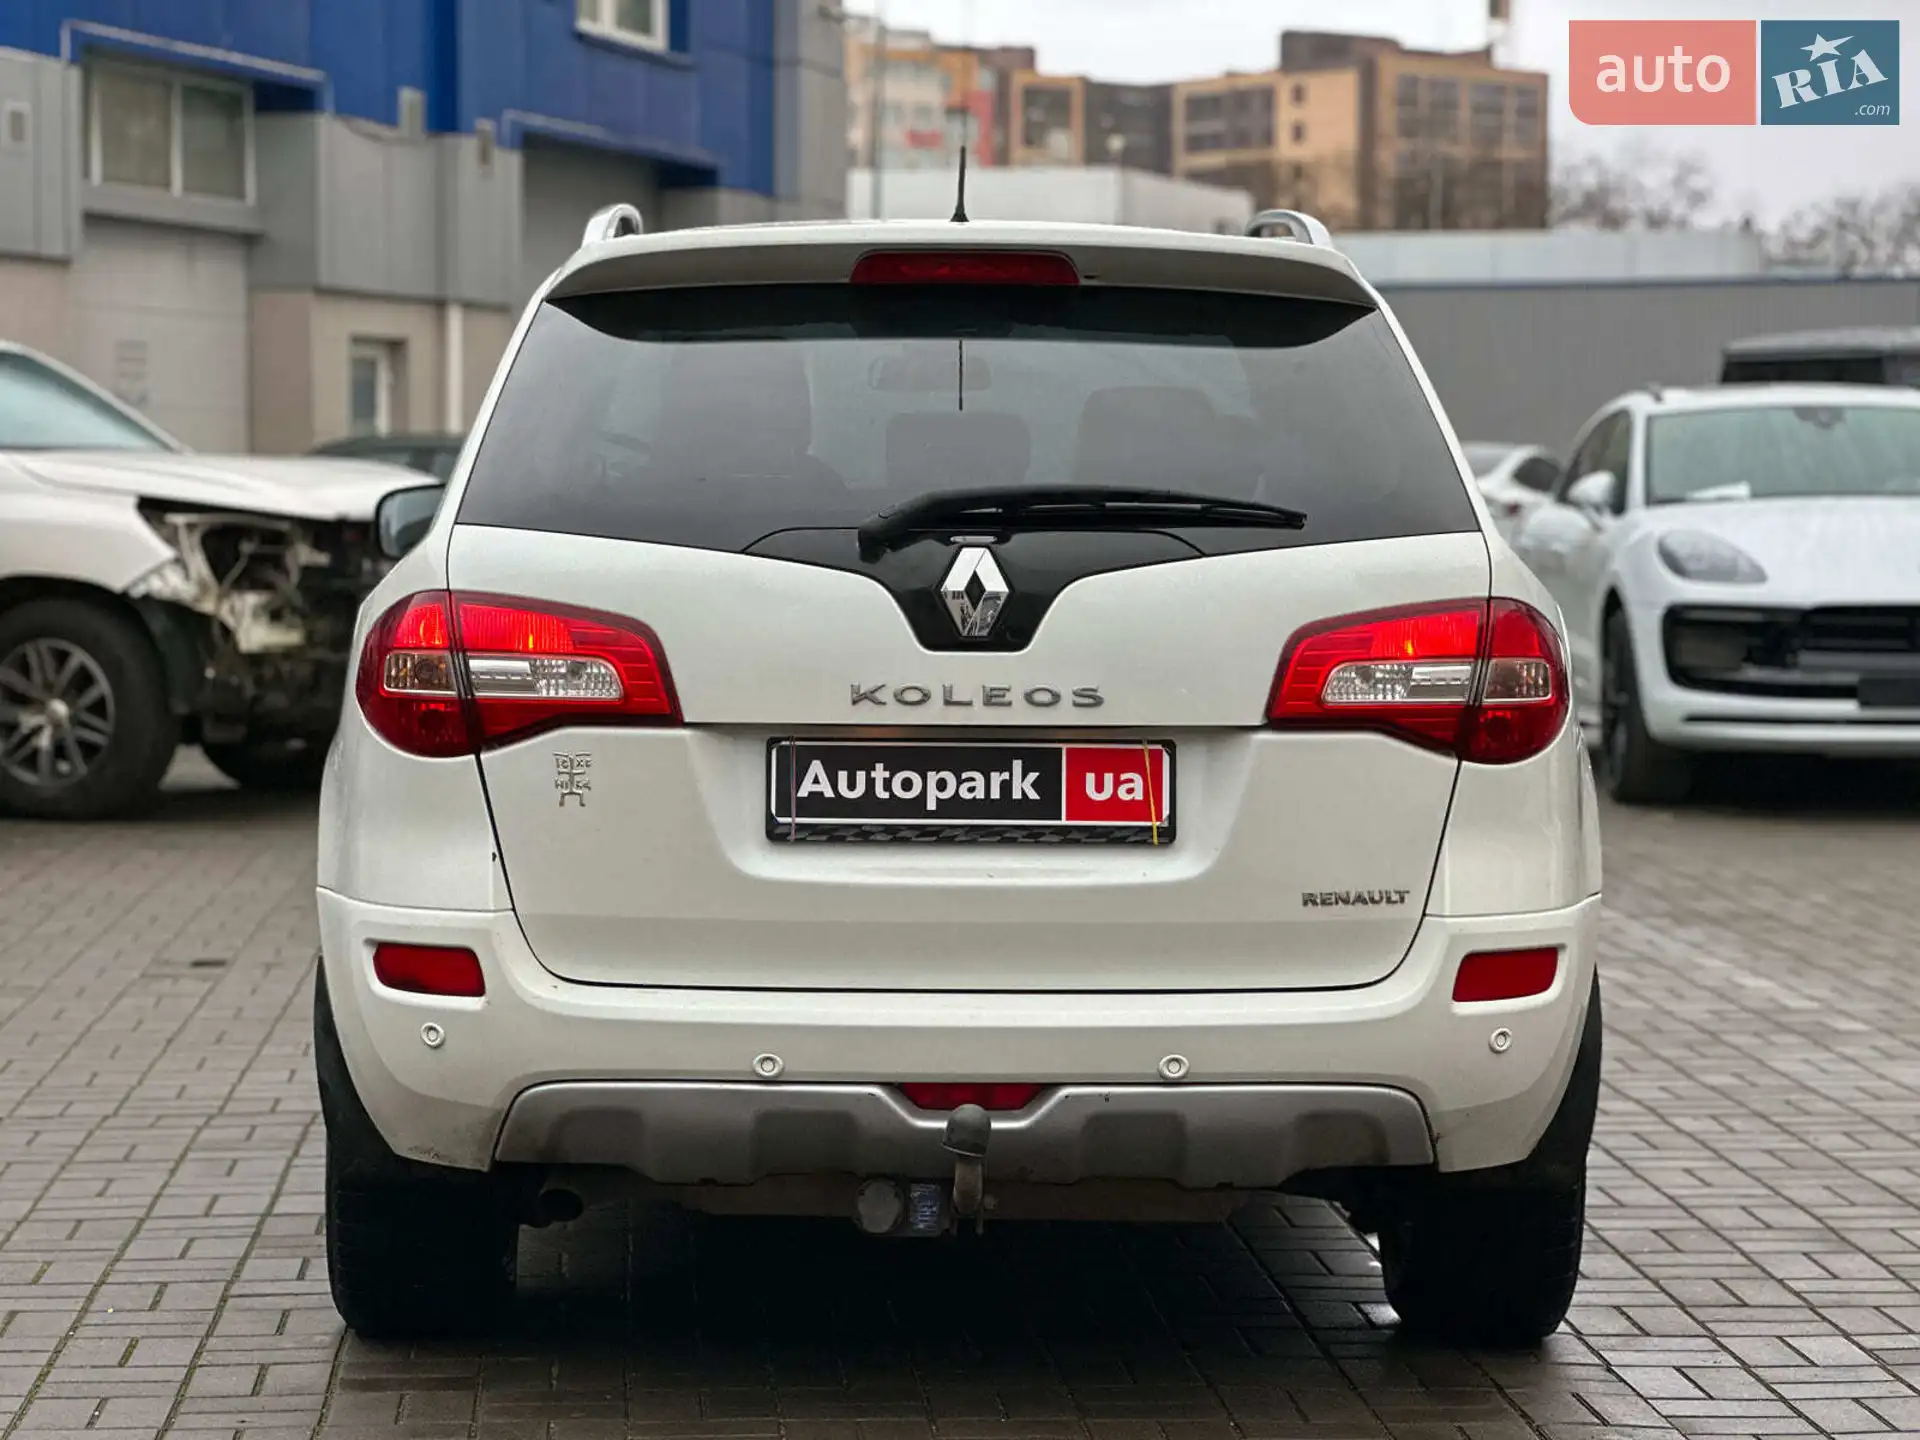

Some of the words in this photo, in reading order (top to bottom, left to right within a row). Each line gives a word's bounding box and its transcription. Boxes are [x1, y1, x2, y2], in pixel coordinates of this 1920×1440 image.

[850, 683, 1105, 708] KOLEOS
[796, 759, 1041, 811] Autopark
[1085, 771, 1144, 801] ua
[1302, 889, 1410, 907] RENAULT
